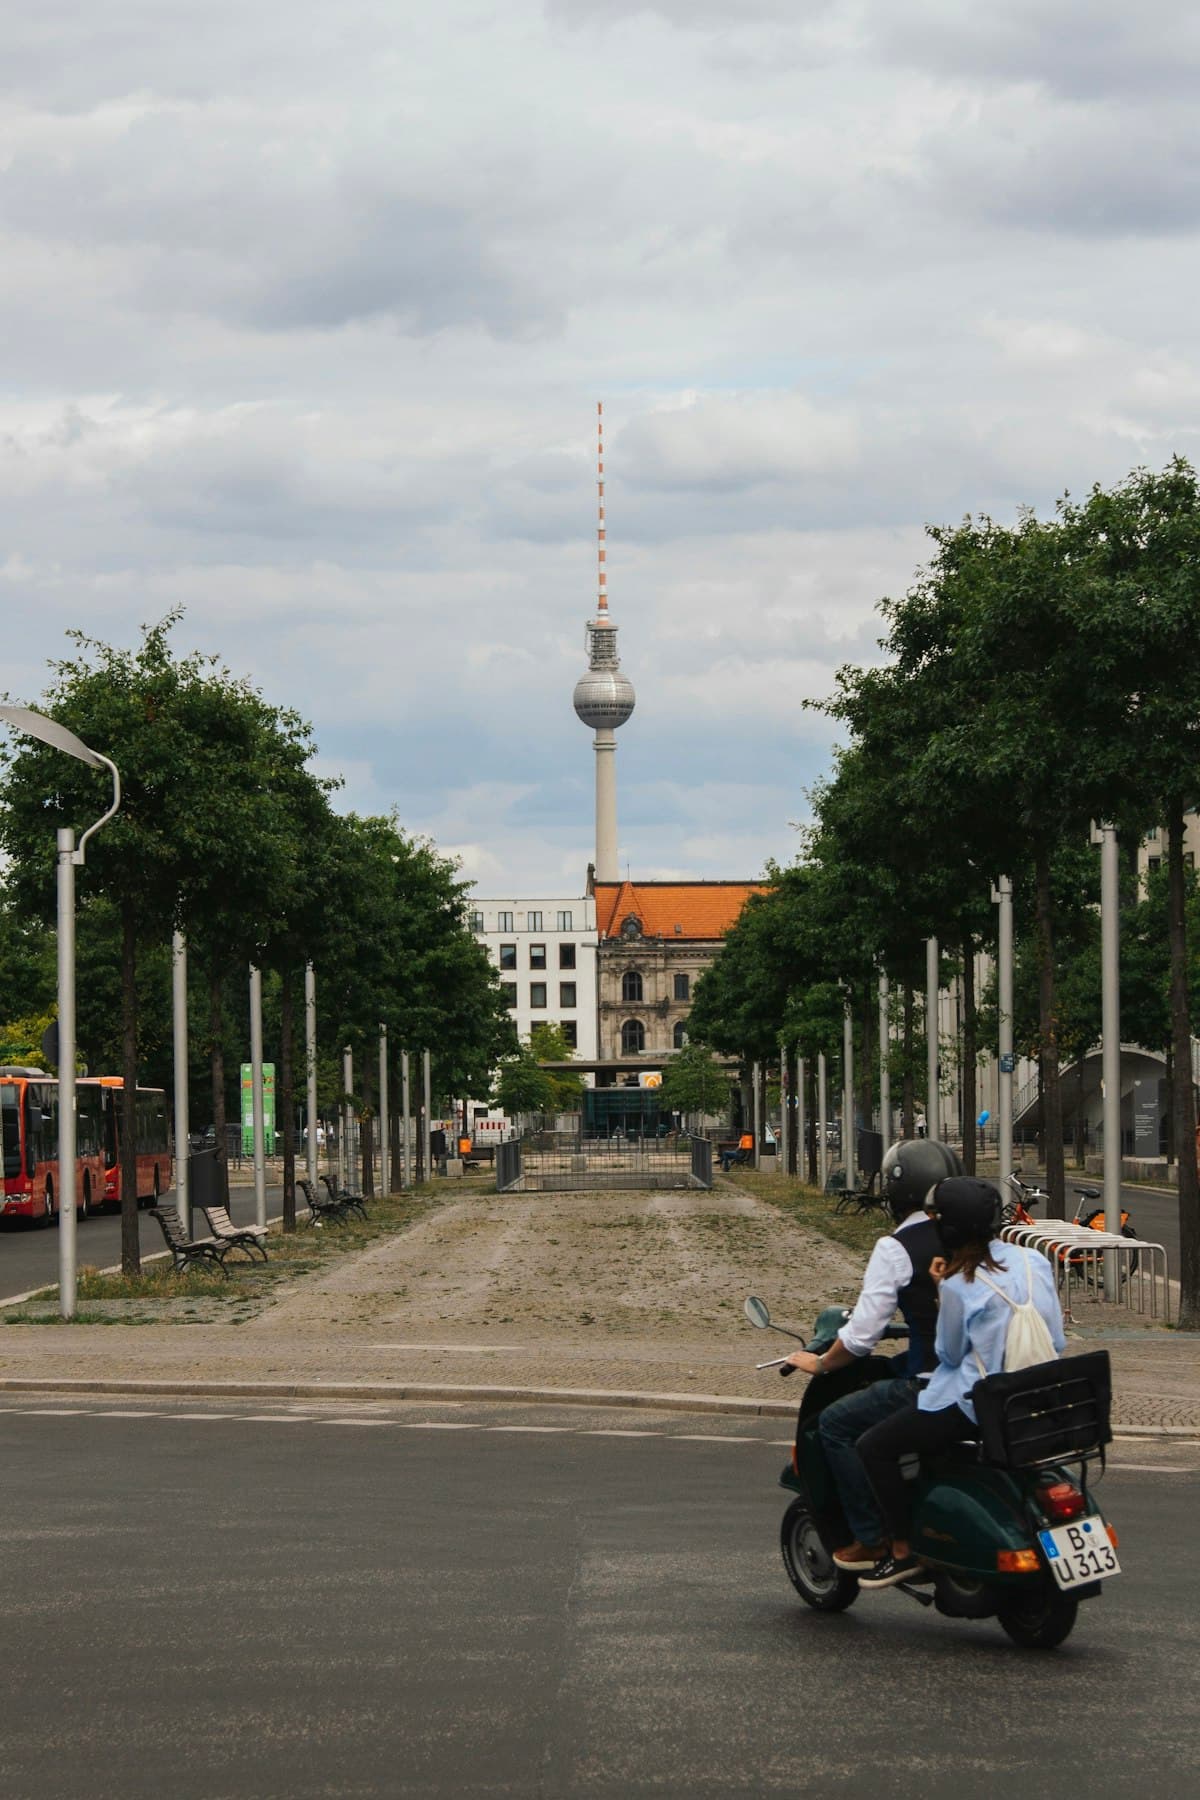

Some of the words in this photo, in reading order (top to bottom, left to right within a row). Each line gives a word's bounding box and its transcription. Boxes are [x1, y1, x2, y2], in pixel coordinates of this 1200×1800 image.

[1066, 1527, 1085, 1551] B
[1055, 1558, 1075, 1582] U
[1073, 1546, 1116, 1577] 313
